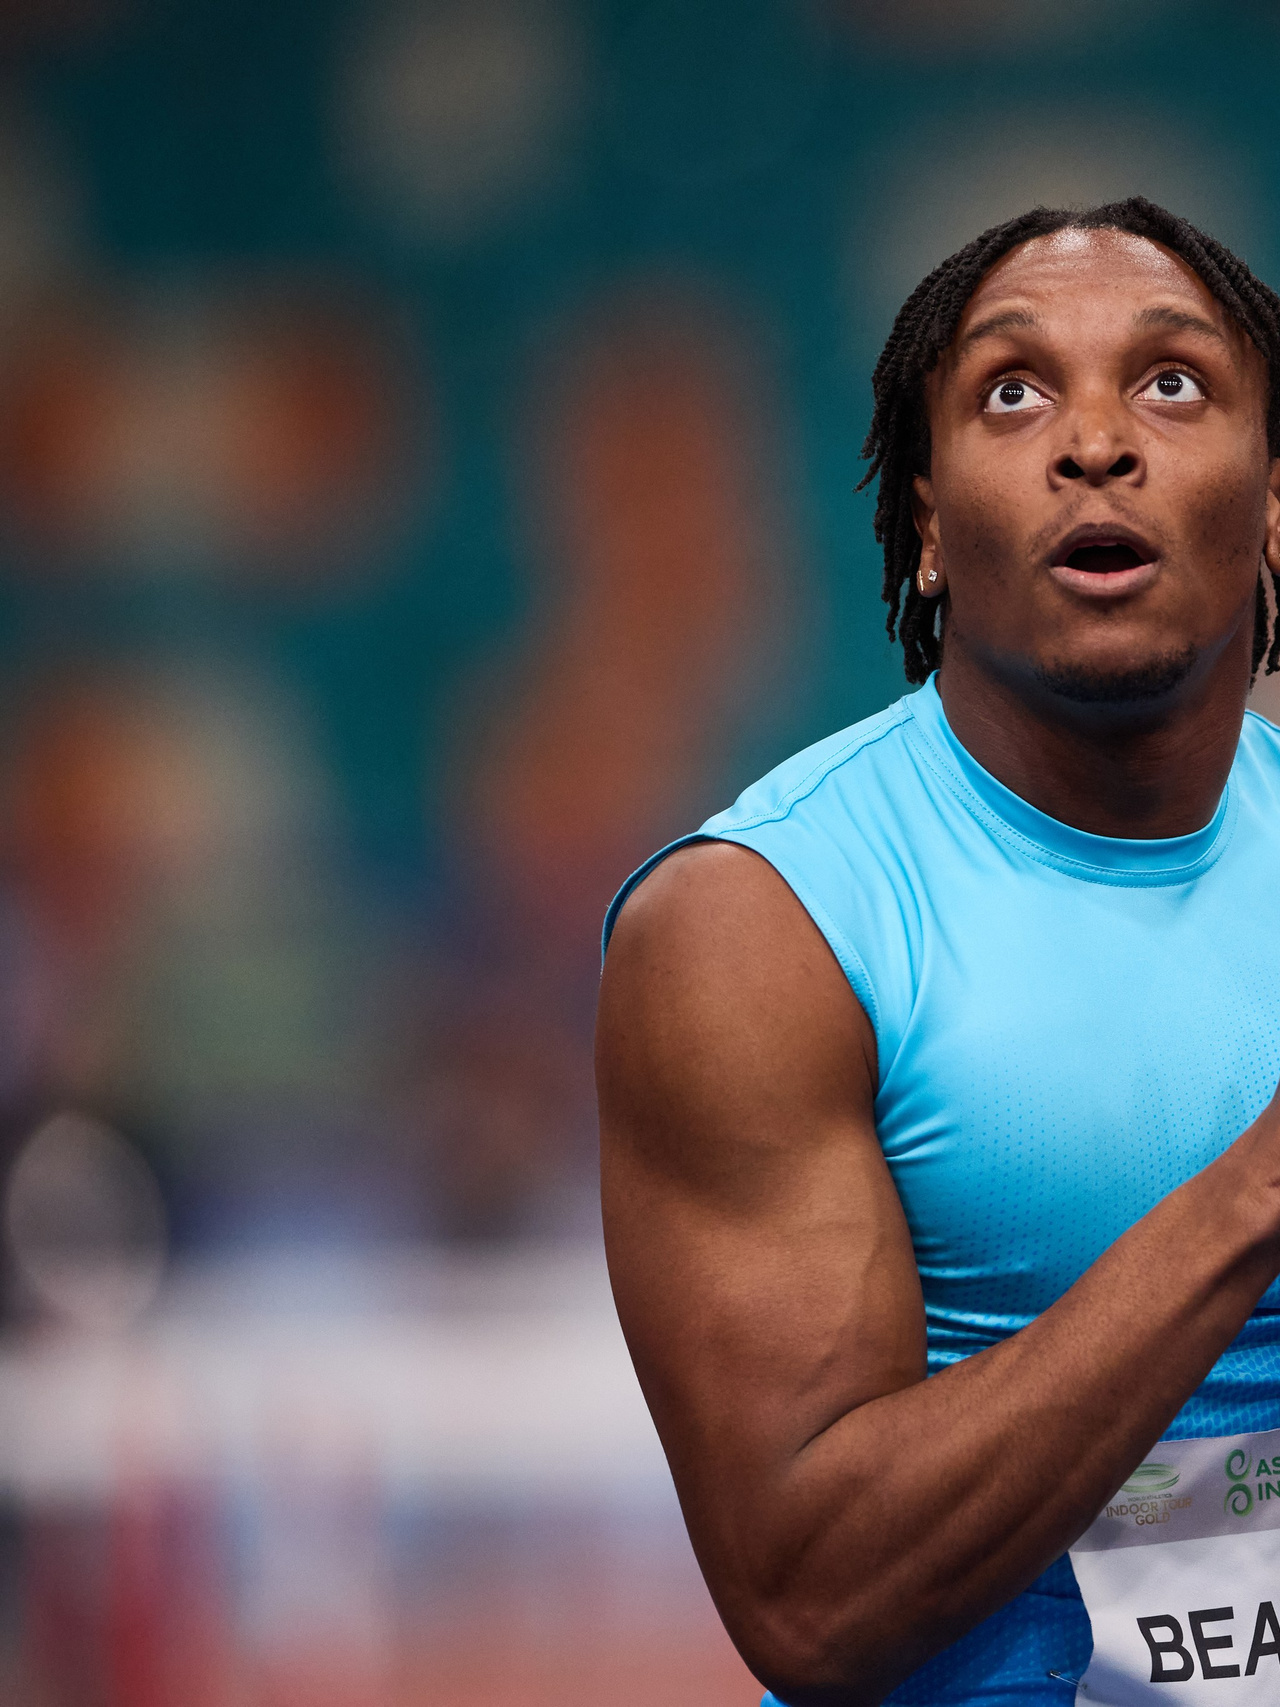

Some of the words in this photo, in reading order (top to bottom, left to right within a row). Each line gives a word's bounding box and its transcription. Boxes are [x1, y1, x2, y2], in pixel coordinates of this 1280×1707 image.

[1105, 1501, 1159, 1518] INDOOR
[1160, 1497, 1193, 1511] TOUR
[1135, 1511, 1171, 1526] GOLD
